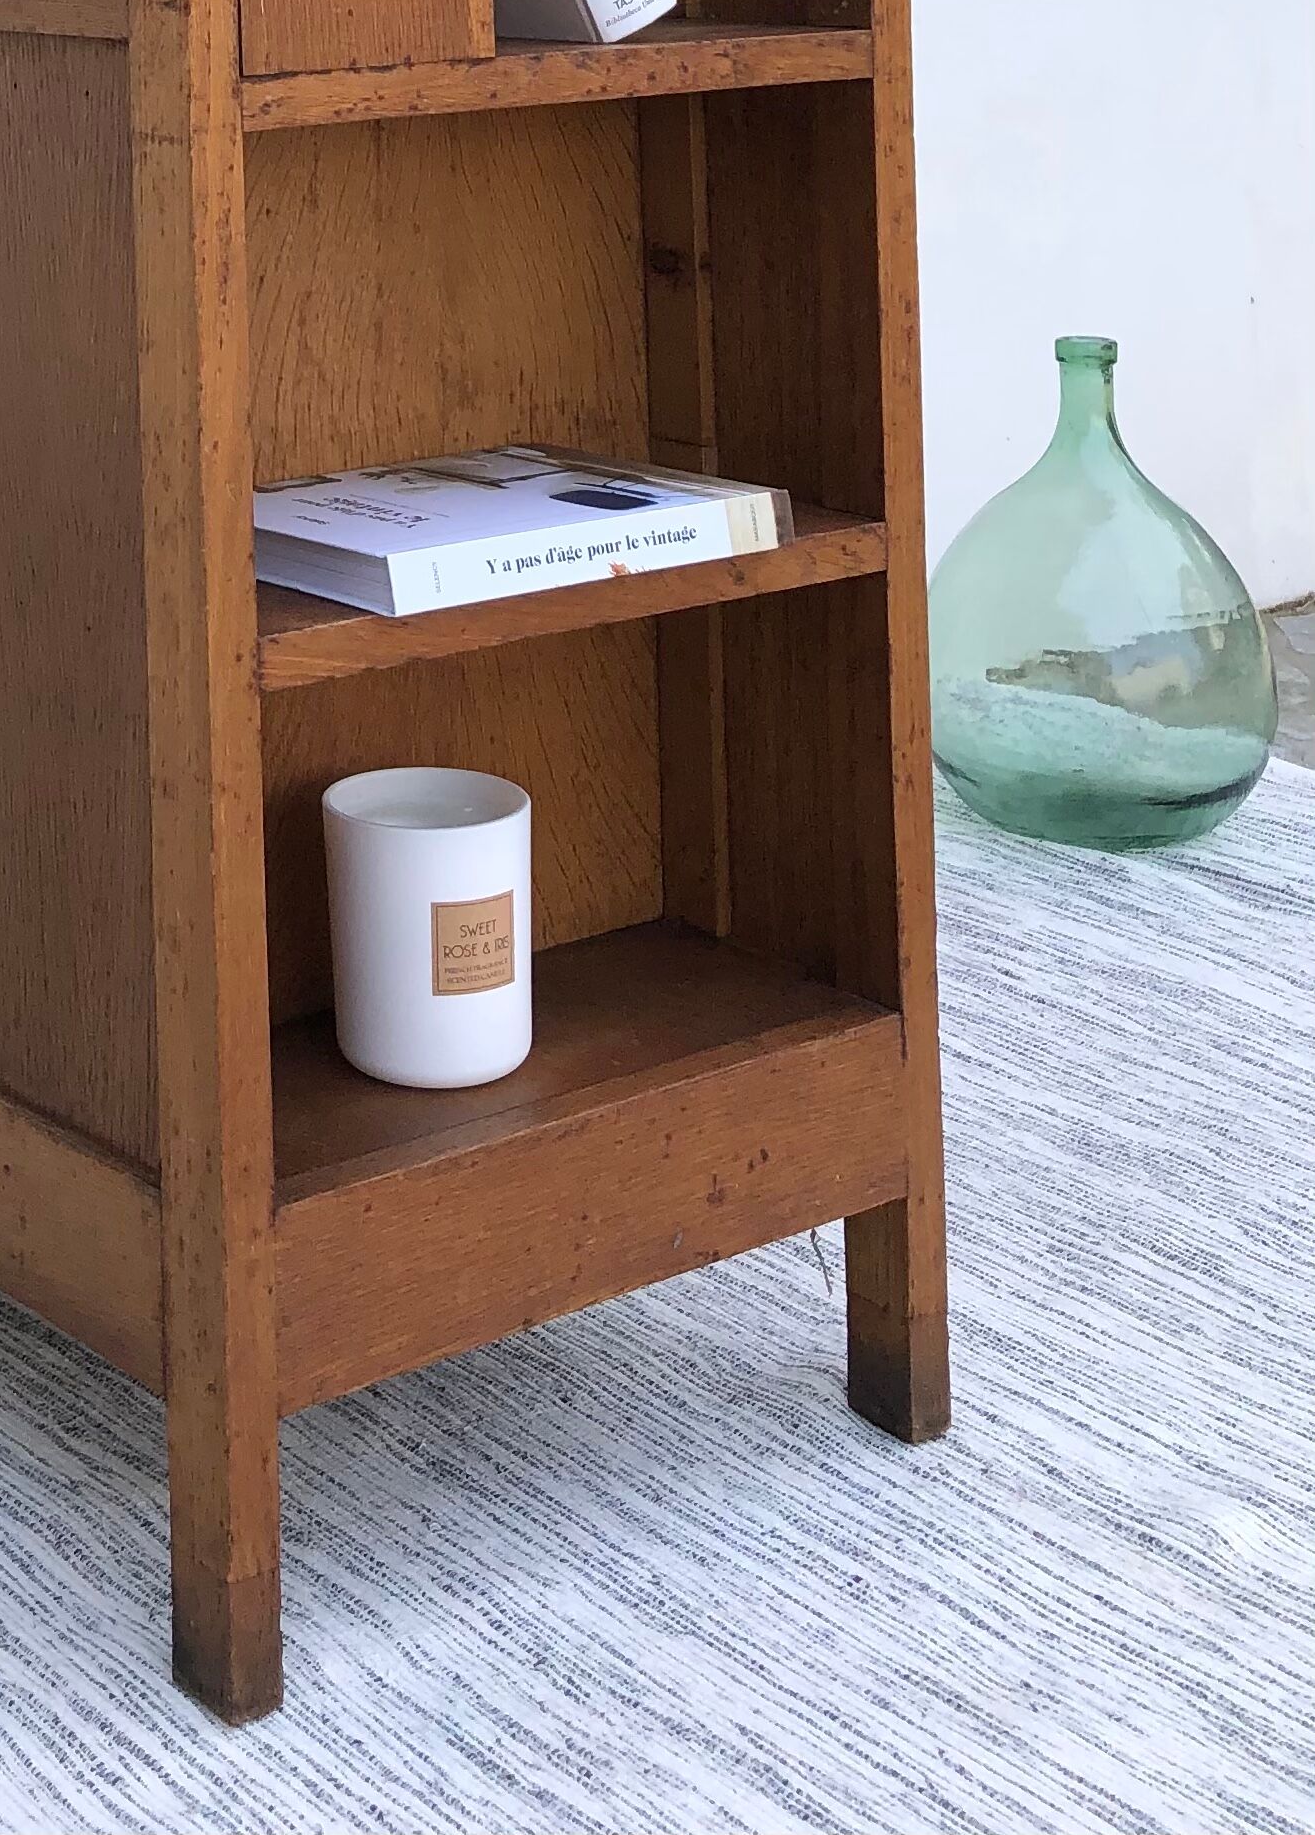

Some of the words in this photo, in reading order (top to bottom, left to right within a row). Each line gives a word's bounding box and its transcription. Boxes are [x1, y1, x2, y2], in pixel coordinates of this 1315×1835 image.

[485, 558, 498, 575] Y
[502, 561, 513, 573] a
[516, 553, 542, 574] pas
[545, 546, 583, 565] d'âge
[587, 539, 623, 561] pour
[626, 534, 640, 551] le
[642, 524, 698, 547] vintage
[459, 918, 497, 939] SWEET
[442, 942, 478, 959] ROSE
[482, 941, 491, 955] &
[494, 934, 509, 953] IRIS
